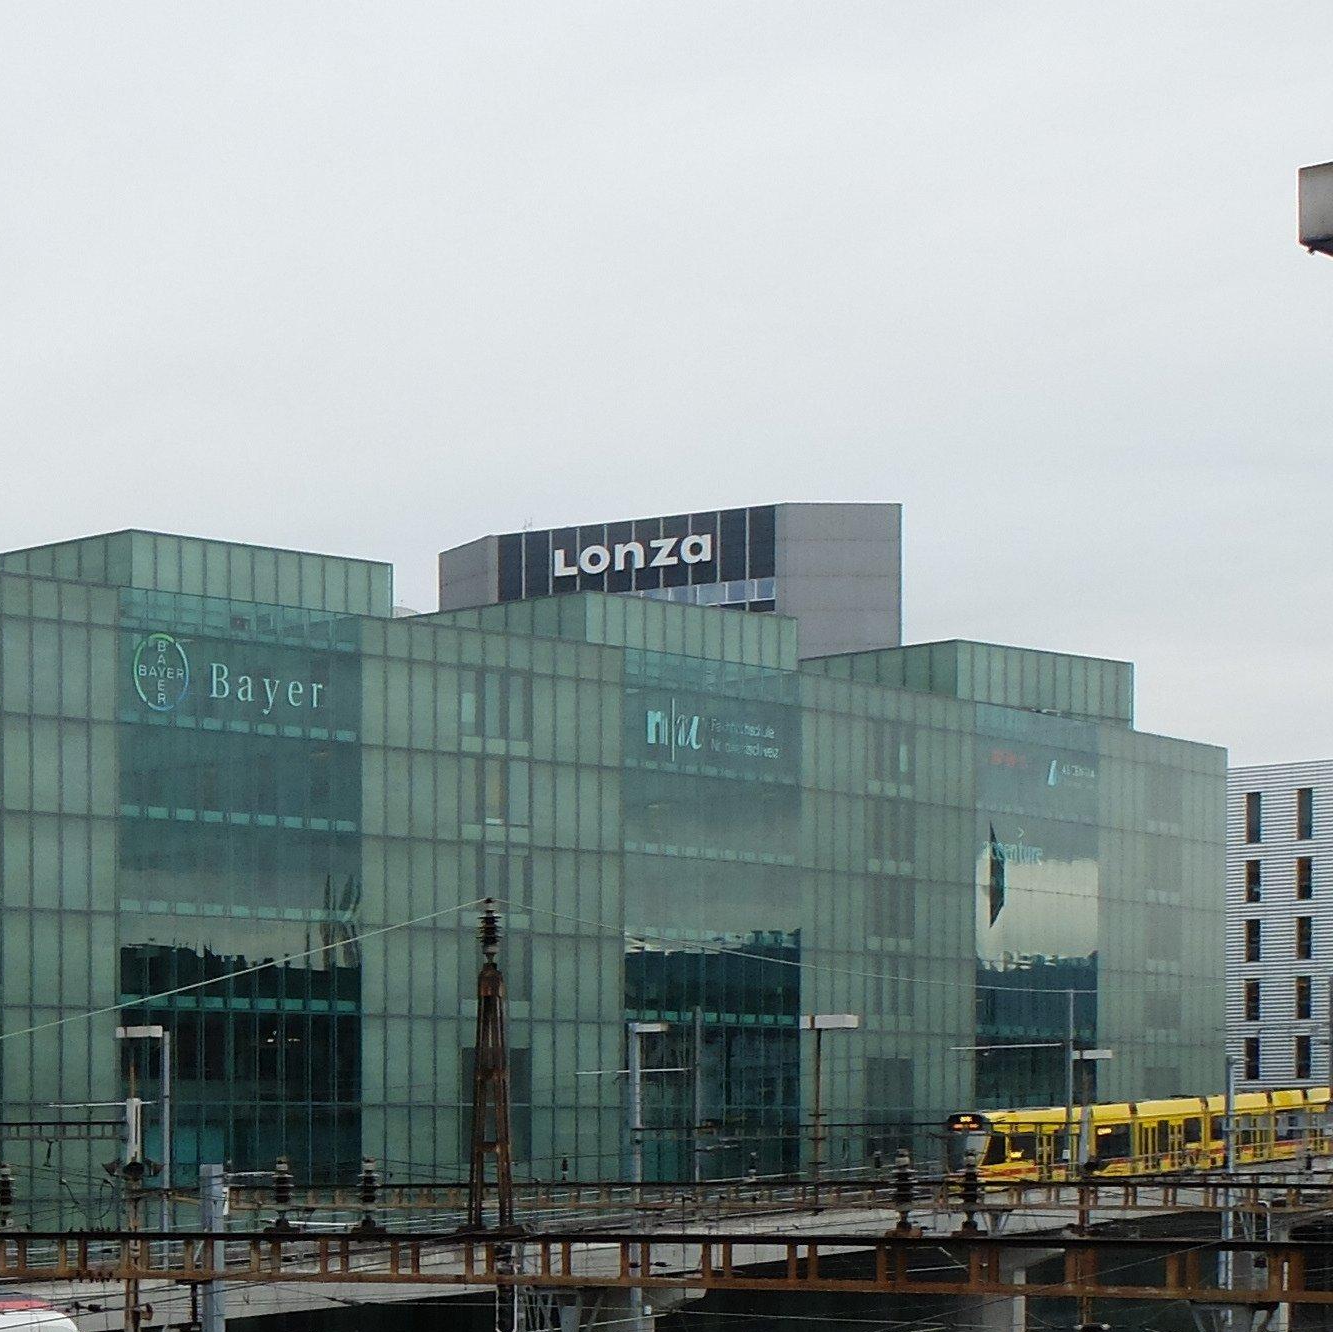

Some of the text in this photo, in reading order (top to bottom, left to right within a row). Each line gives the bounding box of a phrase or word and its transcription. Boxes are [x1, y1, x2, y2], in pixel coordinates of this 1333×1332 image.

[553, 533, 713, 578] Lonza
[138, 664, 185, 680] BAYER
[209, 663, 325, 715] Bayer
